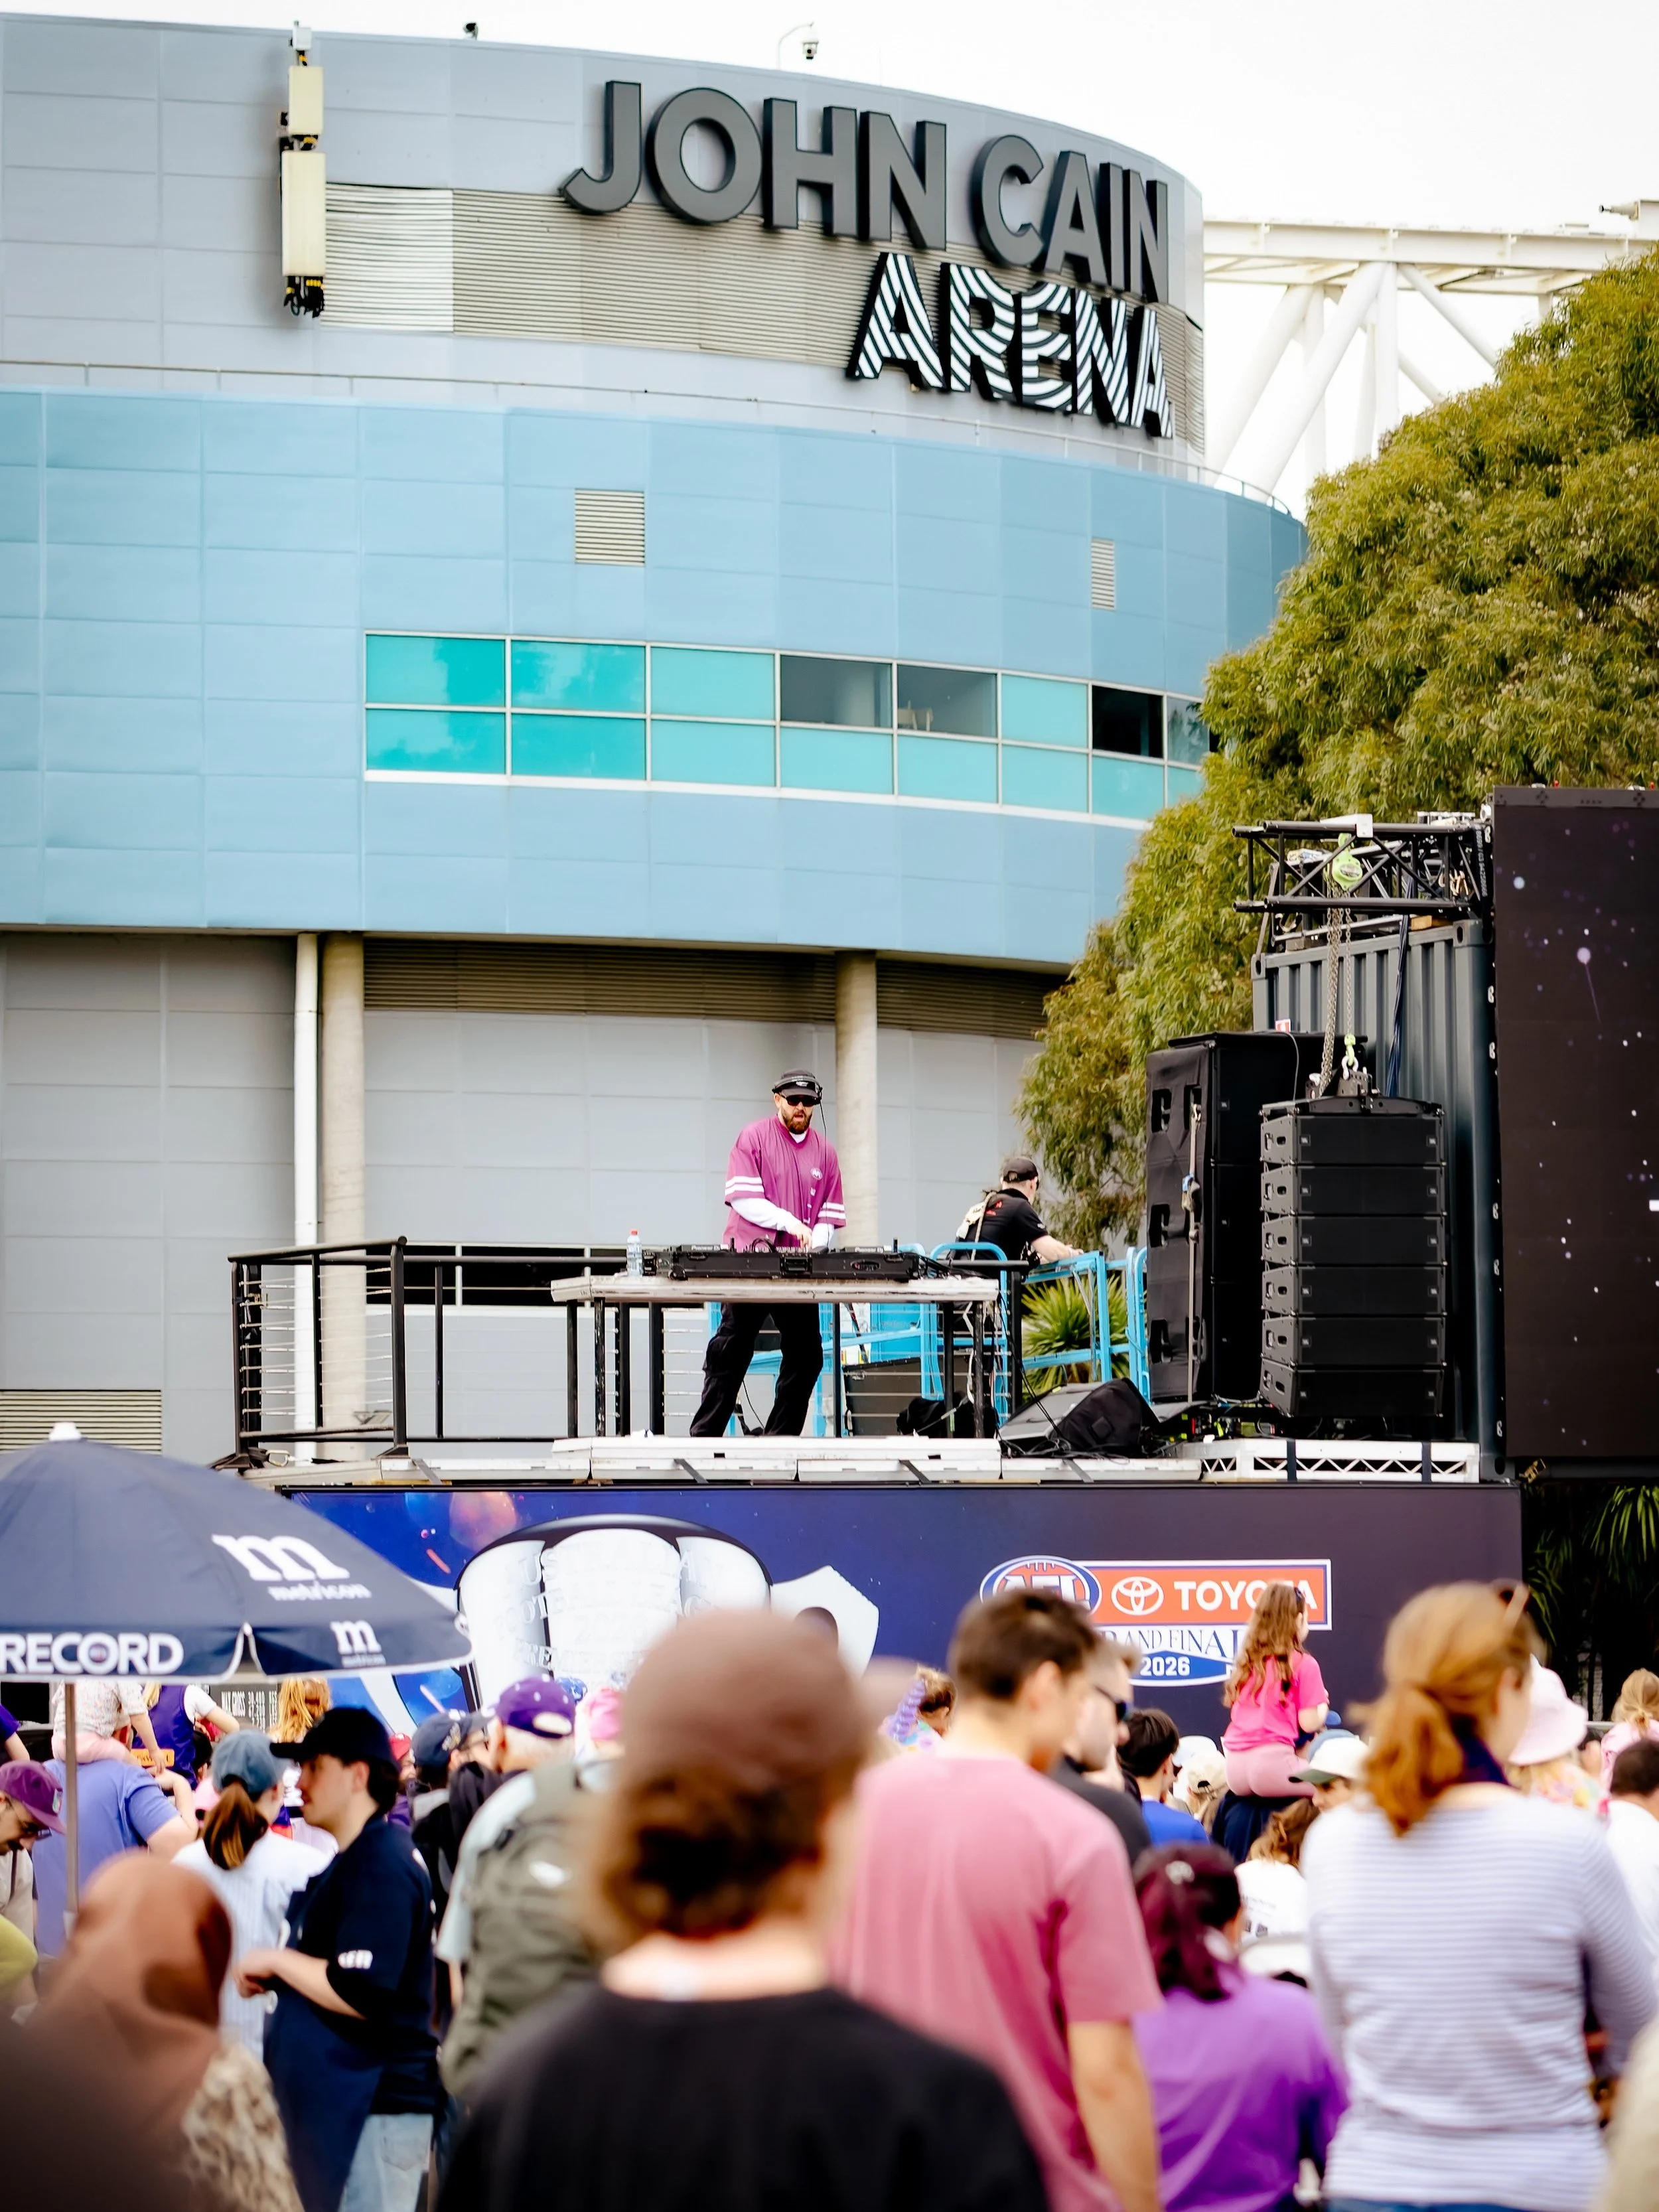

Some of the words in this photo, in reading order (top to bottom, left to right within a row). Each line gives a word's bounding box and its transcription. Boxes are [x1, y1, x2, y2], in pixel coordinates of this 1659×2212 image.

[559, 80, 948, 252] JOHN
[971, 135, 1169, 303] CAIN
[845, 252, 1173, 439] ARENA
[1173, 1580, 1318, 1611] TOYOA
[0, 1632, 184, 1675] RECORD
[1140, 1657, 1190, 1676] 2026
